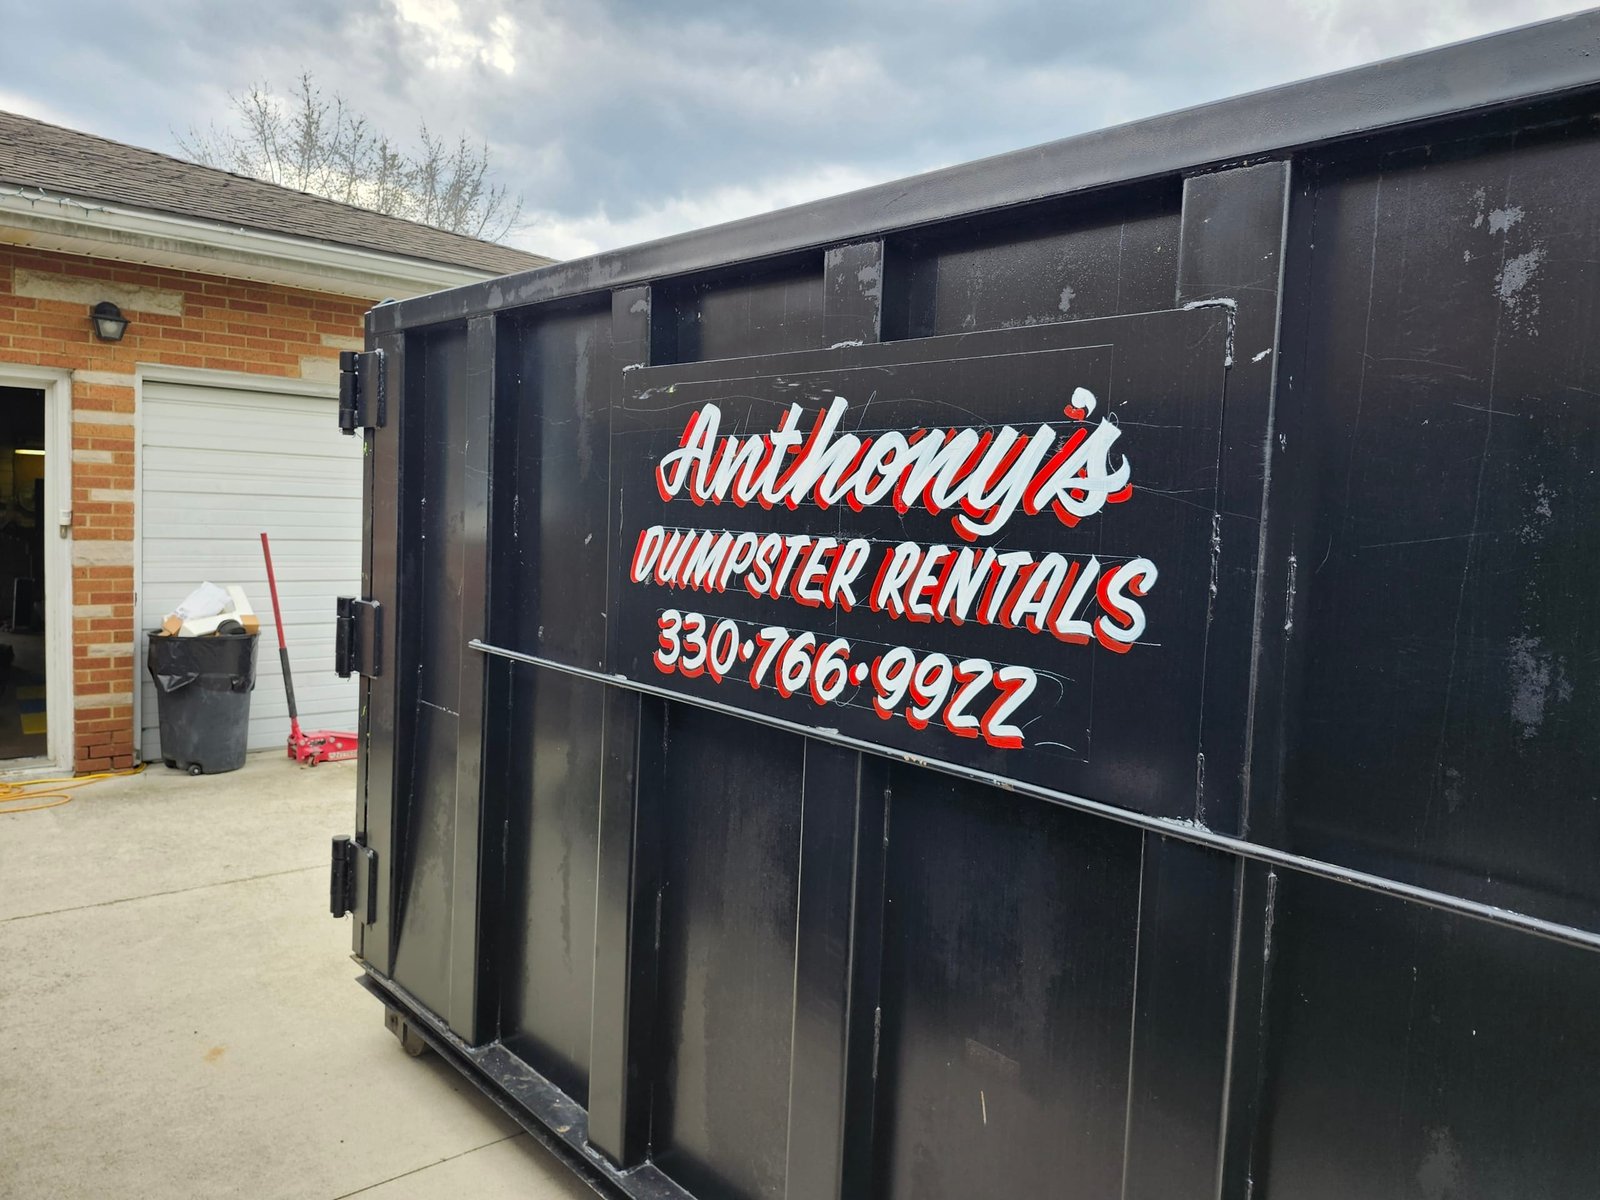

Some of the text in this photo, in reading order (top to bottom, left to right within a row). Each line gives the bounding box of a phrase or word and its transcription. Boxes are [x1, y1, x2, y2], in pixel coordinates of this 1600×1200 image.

[656, 387, 1132, 540] Anthony's
[630, 525, 1158, 653] DUMPSTER RENTALS
